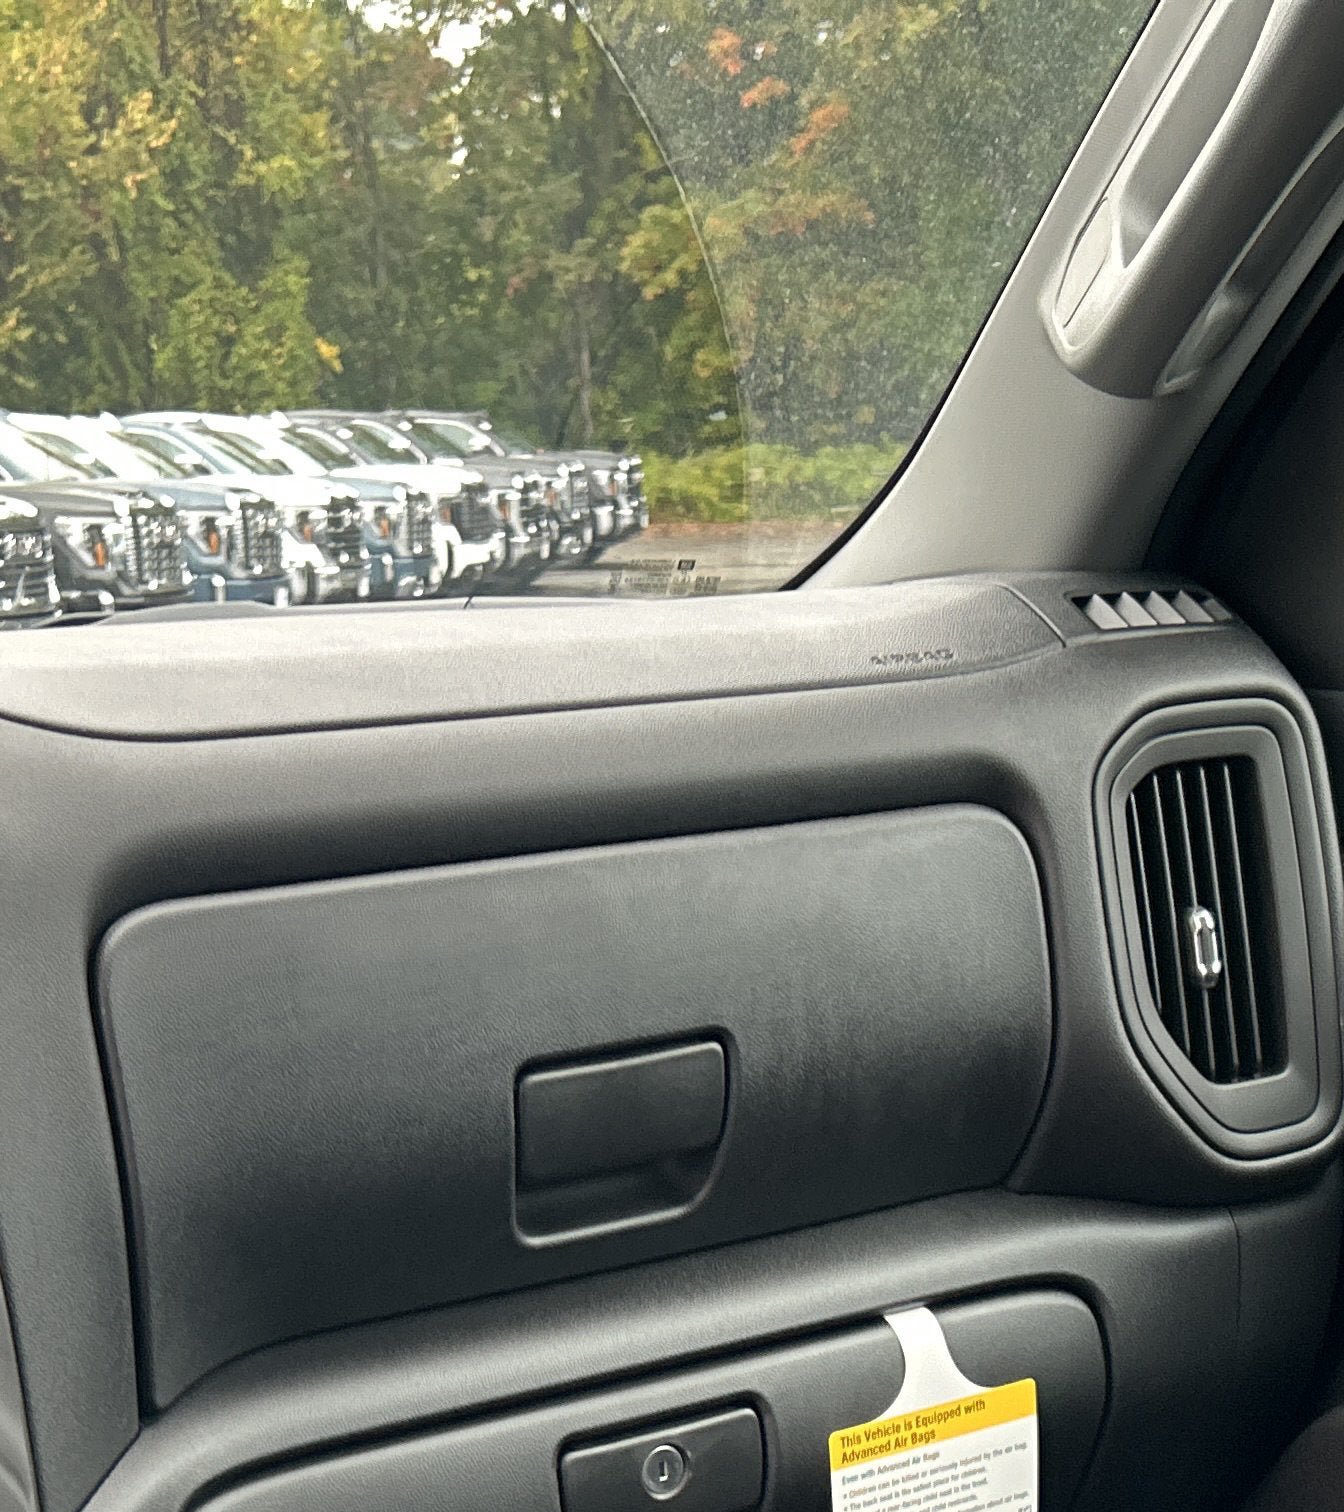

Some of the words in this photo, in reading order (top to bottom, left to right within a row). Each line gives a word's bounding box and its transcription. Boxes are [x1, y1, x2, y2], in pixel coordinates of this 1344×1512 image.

[840, 1434, 862, 1449] This
[864, 1422, 901, 1442] Vehicle
[904, 1417, 913, 1431] is
[916, 1404, 961, 1428] Equipped
[963, 1399, 986, 1415] with
[841, 1440, 891, 1464] Advanced
[894, 1436, 909, 1451] Air
[911, 1429, 936, 1444] Bags
